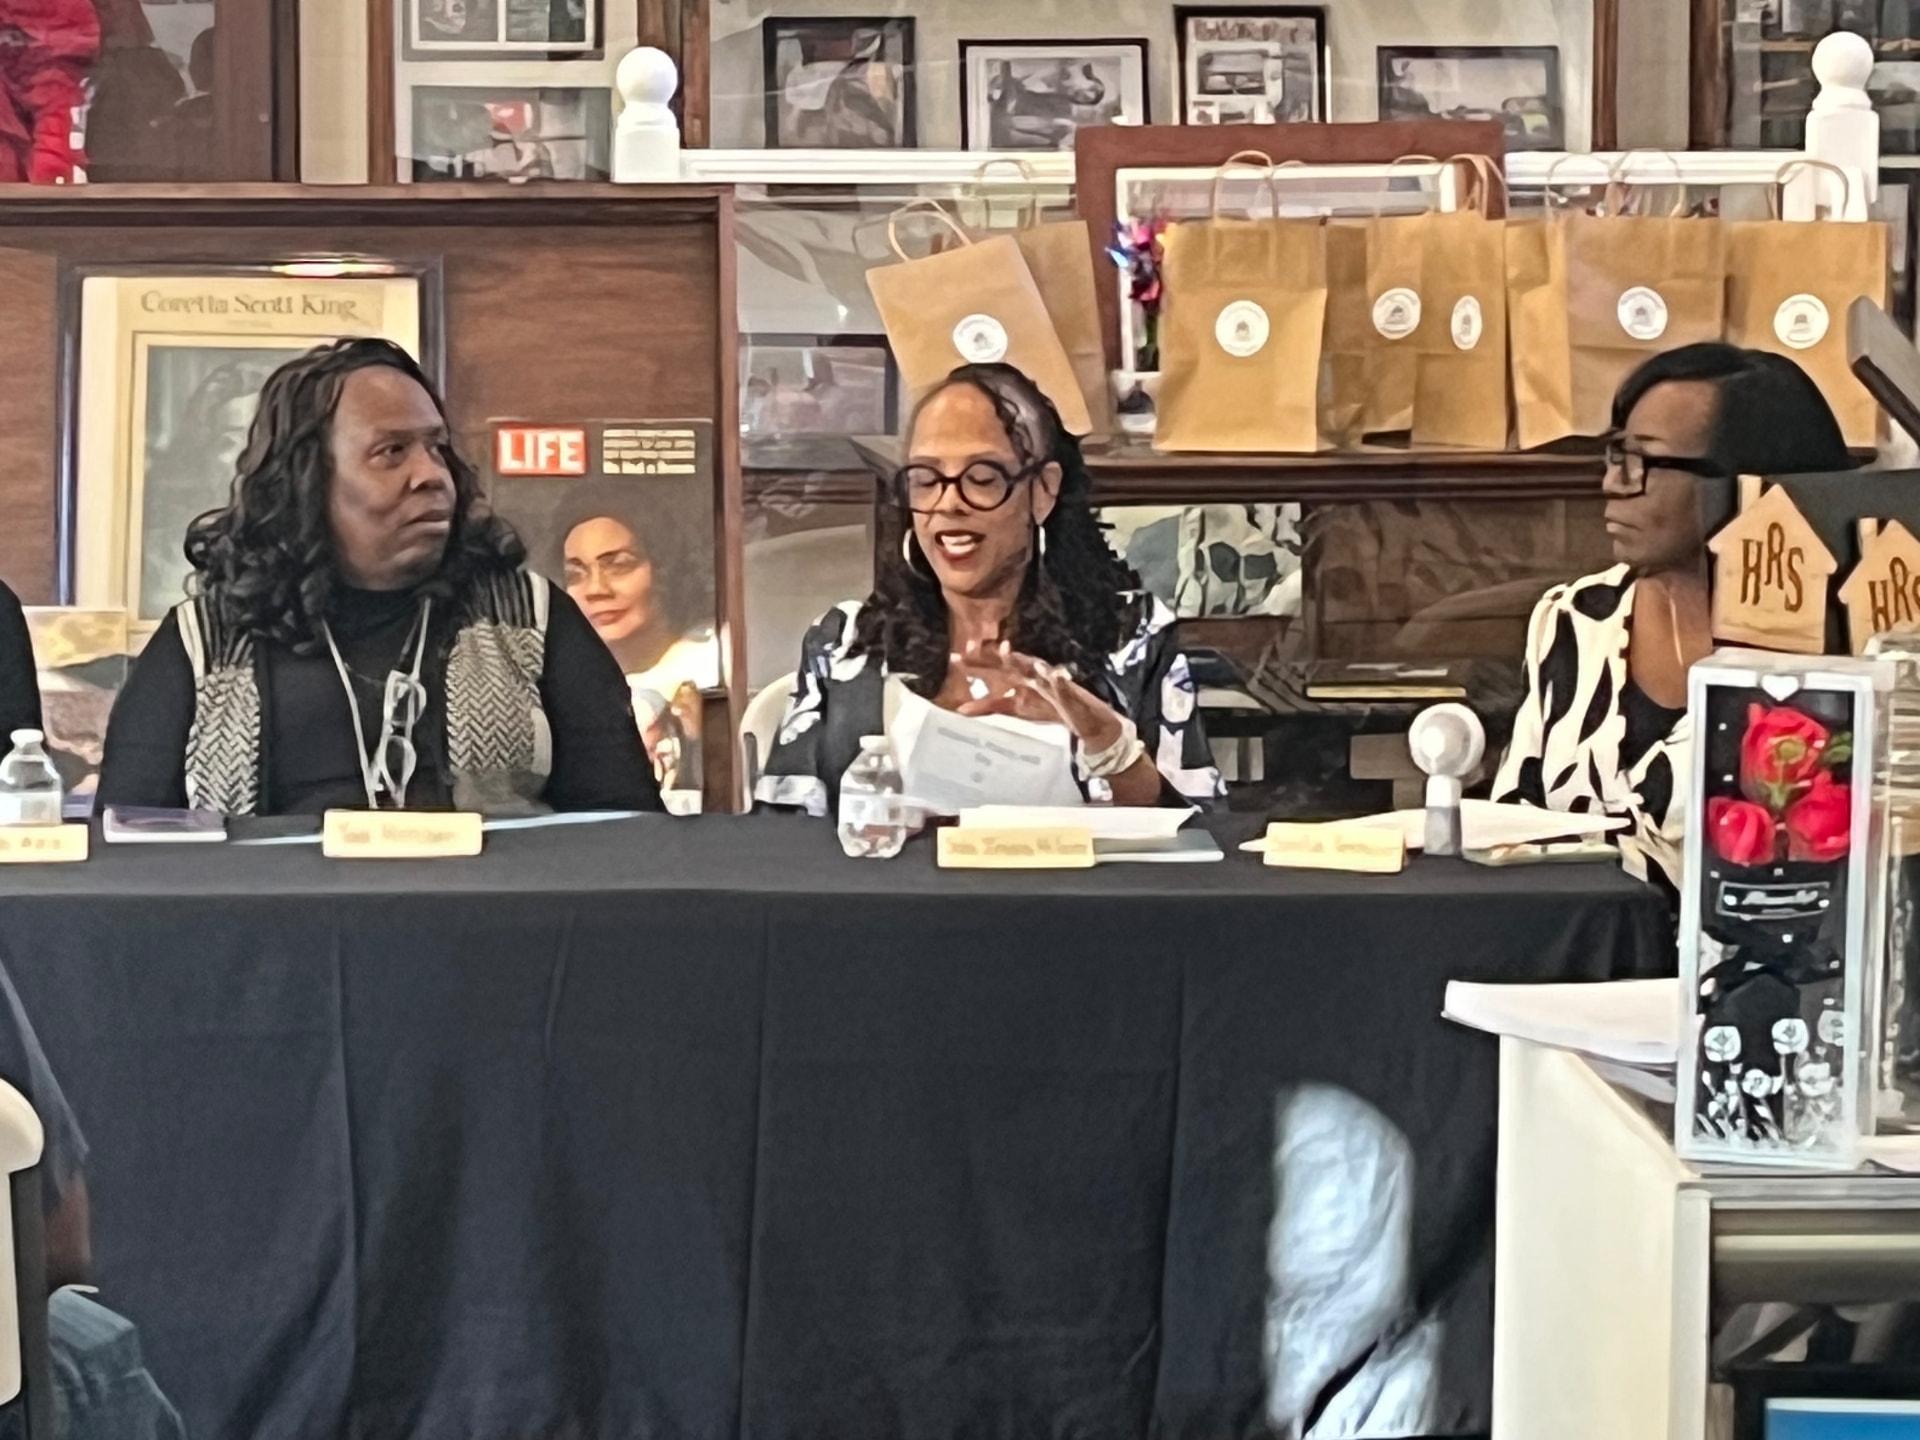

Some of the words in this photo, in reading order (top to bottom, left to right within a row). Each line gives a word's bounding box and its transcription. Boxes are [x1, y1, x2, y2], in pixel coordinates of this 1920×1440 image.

[302, 293, 357, 321] King
[501, 431, 584, 471] LIFE
[1740, 521, 1804, 613] HRS
